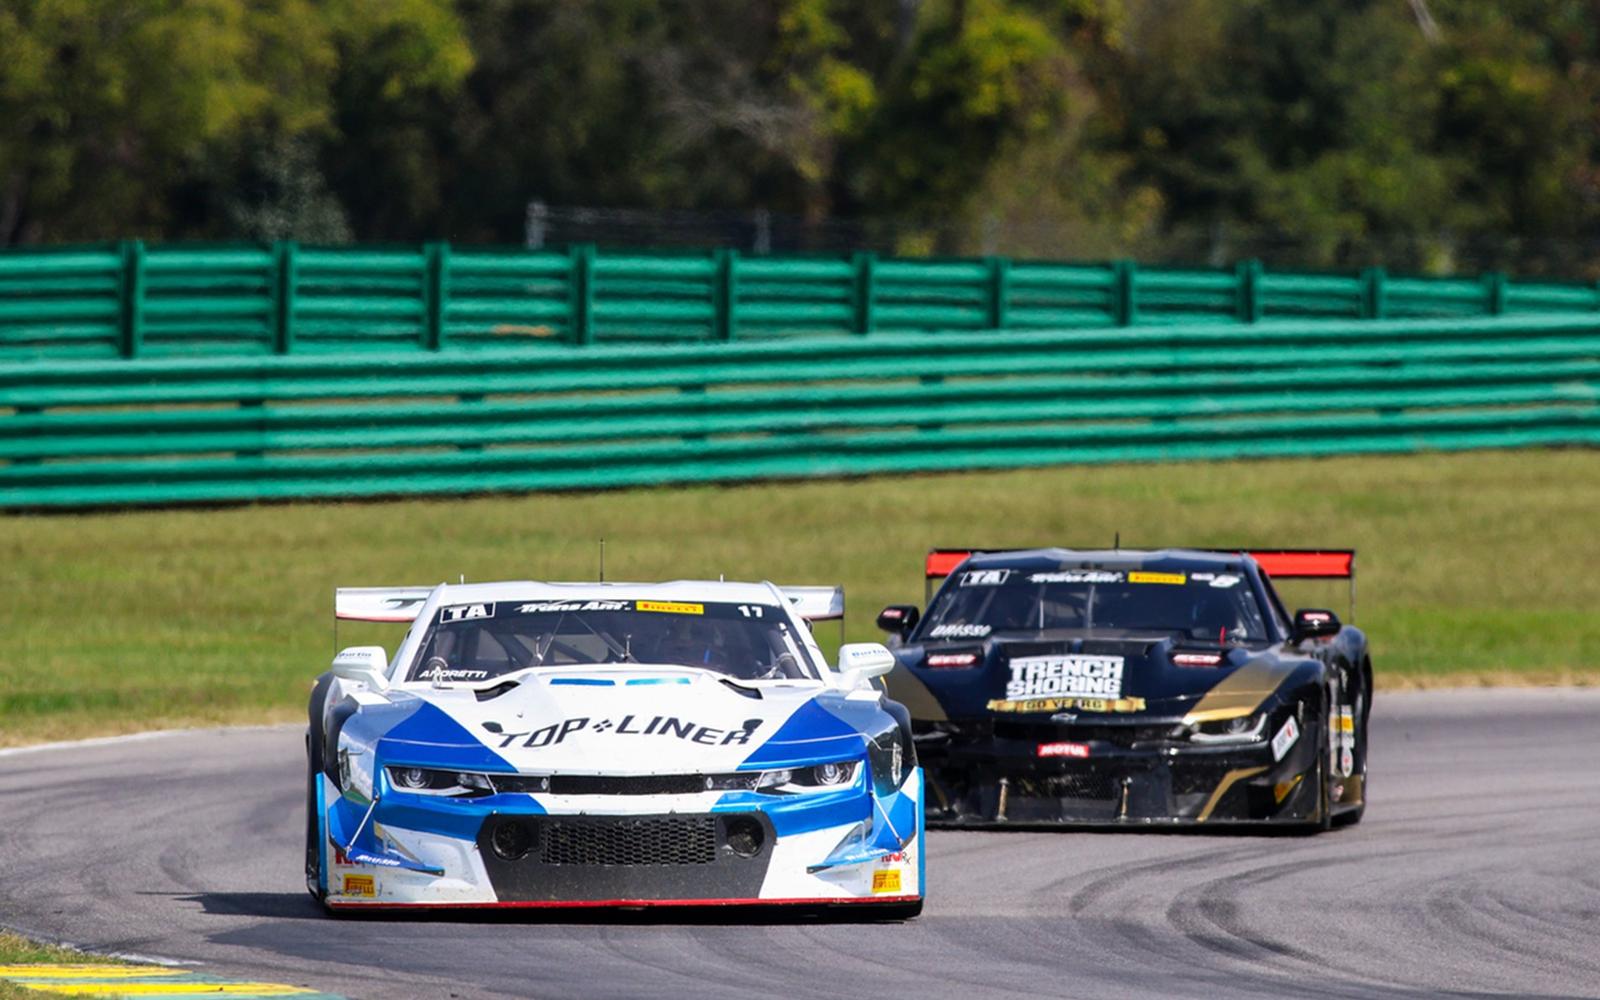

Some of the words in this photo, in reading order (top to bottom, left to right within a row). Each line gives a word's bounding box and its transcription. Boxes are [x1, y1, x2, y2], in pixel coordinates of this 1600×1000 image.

[969, 571, 1001, 584] TA
[447, 604, 488, 620] TA
[737, 604, 763, 618] 17
[1009, 656, 1124, 682] TRENCH
[1006, 676, 1121, 697] SHORING
[498, 716, 591, 748] TOP
[615, 714, 755, 746] LINER
[1040, 743, 1086, 757] MOTUL
